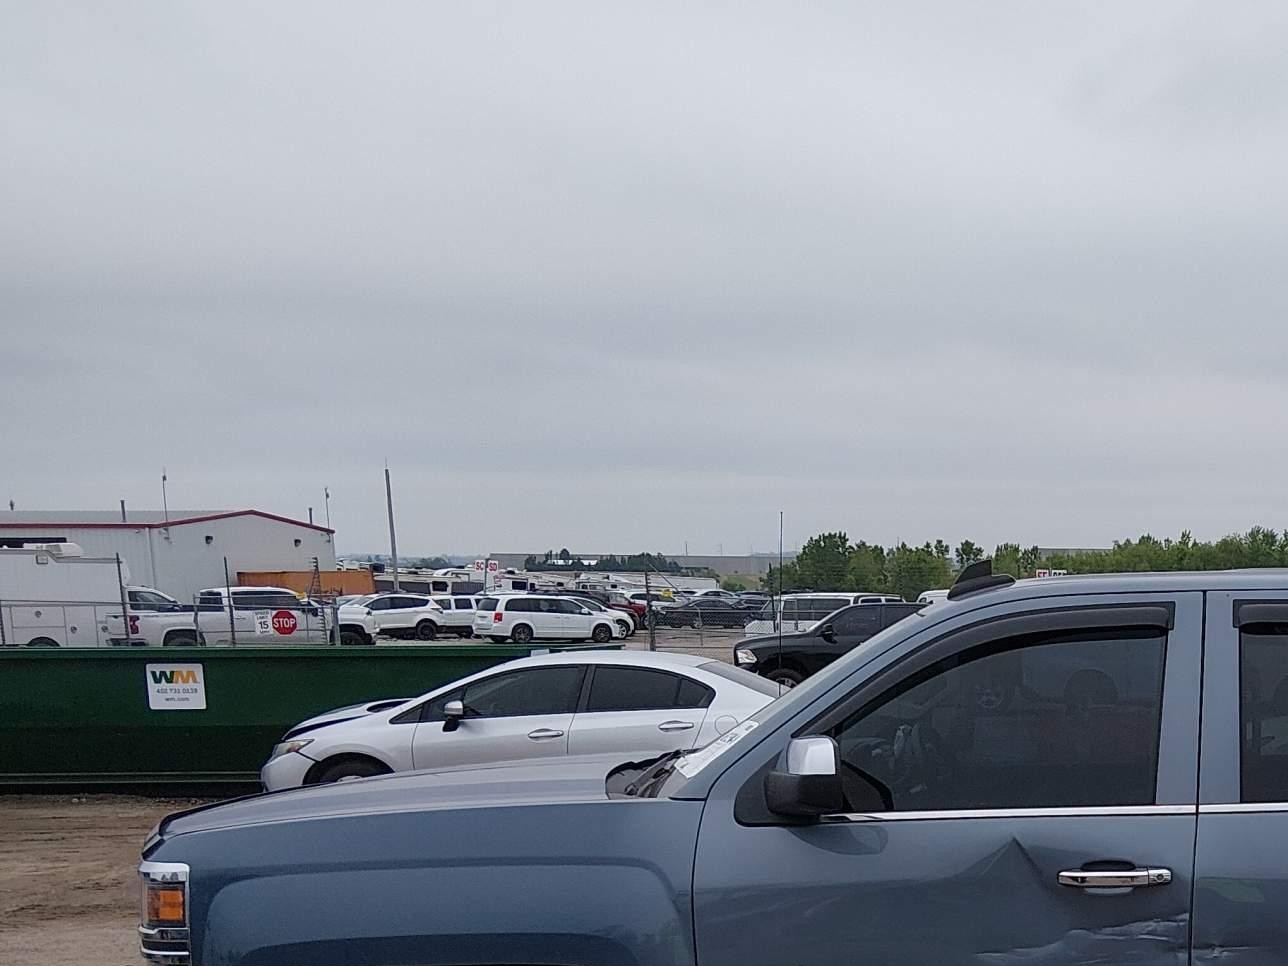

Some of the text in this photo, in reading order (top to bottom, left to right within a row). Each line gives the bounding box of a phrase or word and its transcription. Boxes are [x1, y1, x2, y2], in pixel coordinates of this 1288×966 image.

[258, 620, 269, 630] 15
[273, 618, 296, 628] STOP
[150, 671, 199, 684] WM
